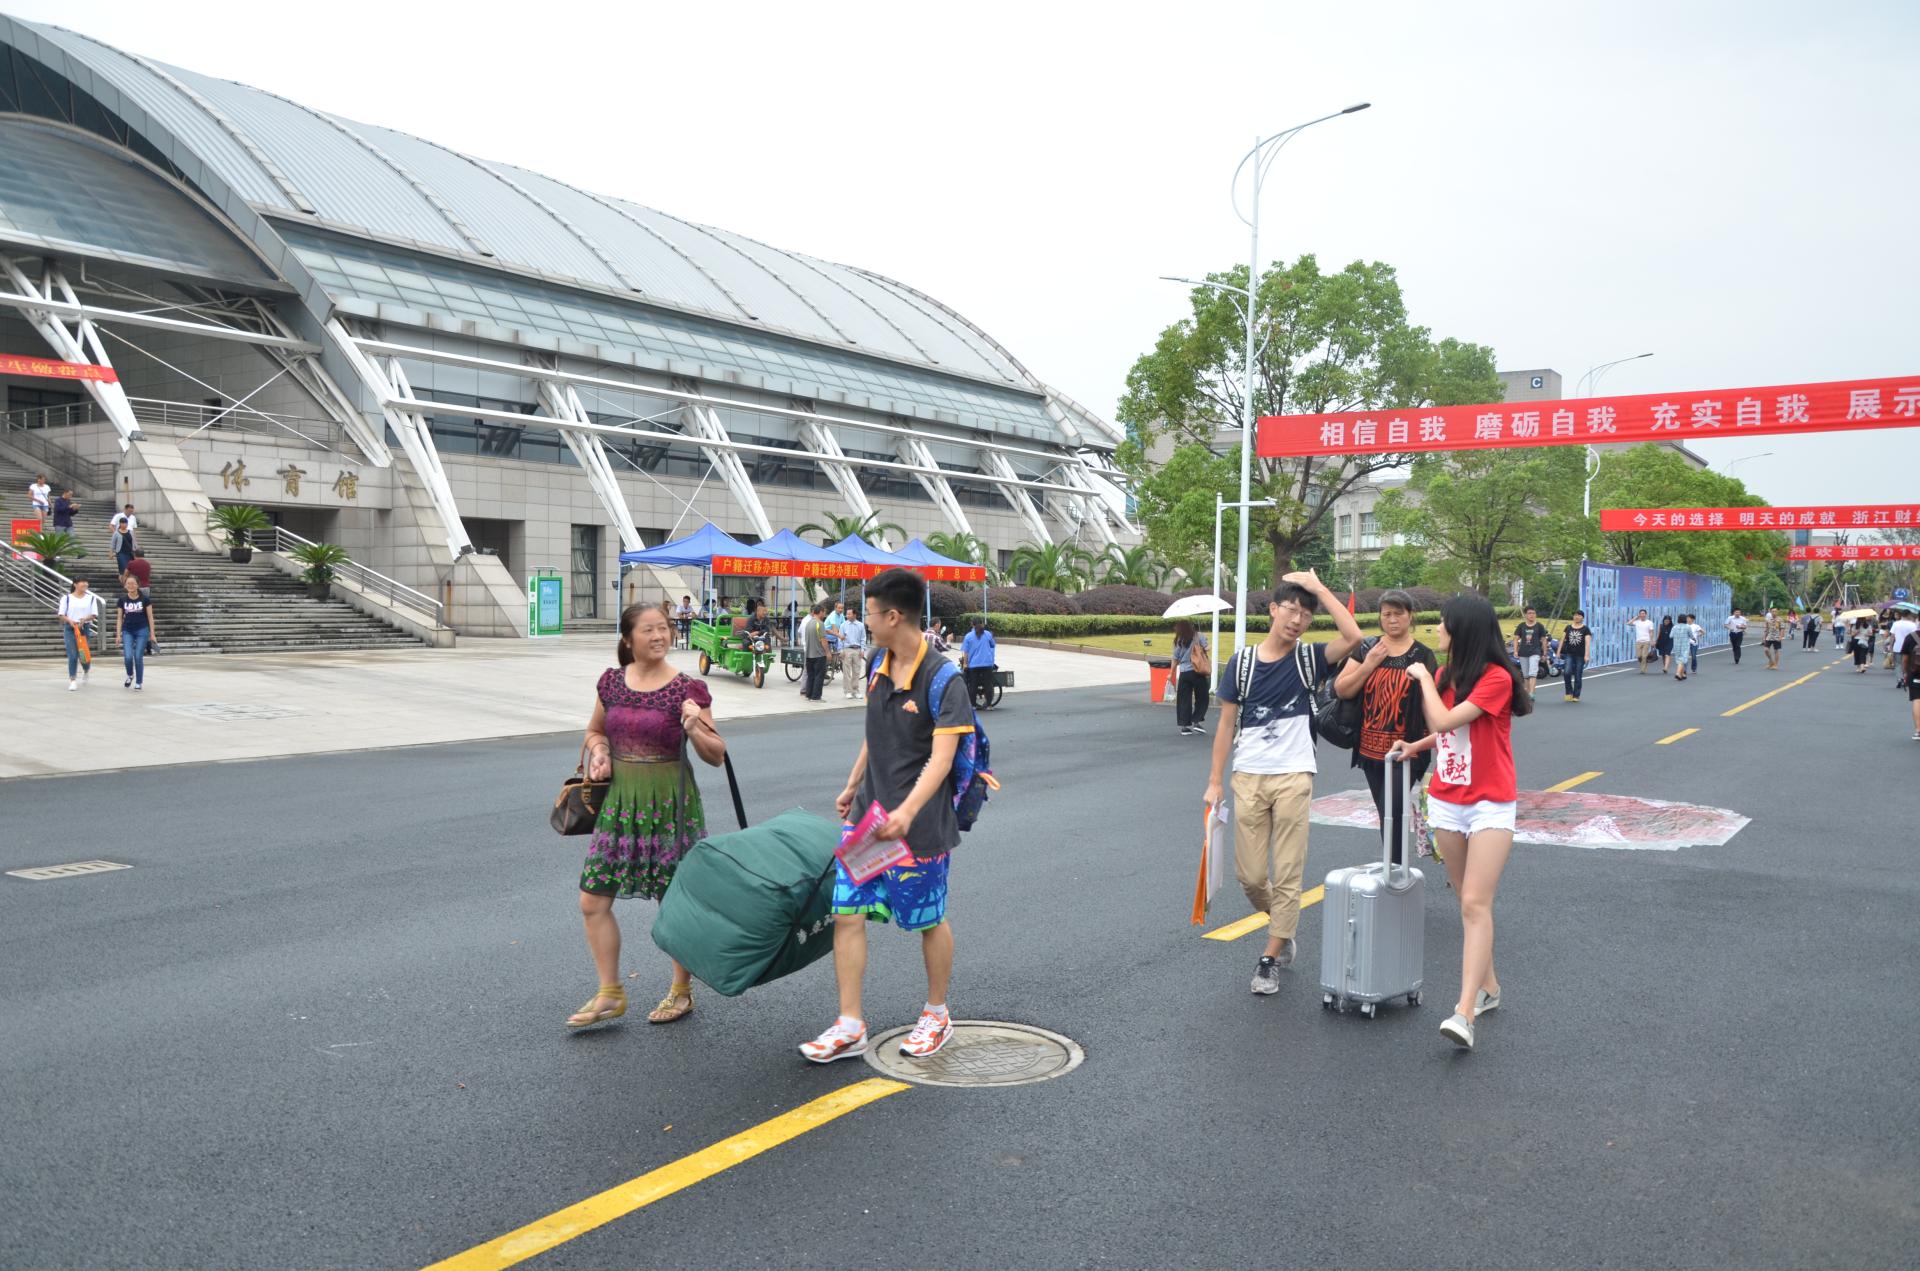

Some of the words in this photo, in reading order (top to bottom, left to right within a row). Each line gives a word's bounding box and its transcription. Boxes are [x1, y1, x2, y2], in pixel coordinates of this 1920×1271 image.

[1532, 377, 1541, 387] C
[1320, 416, 1446, 446] 相信自我
[1474, 406, 1616, 439] 磨砺自我
[1651, 394, 1809, 431] 充实自我
[1847, 388, 1920, 419] 展示
[220, 459, 359, 500] 体育馆
[1633, 512, 1724, 526] 今天的选择
[1740, 511, 1836, 525] 明天的成就
[1852, 510, 1920, 524] 浙江财
[723, 558, 788, 574] 户籍迁移办理区
[803, 562, 858, 577] 户籍迁移办理区
[937, 568, 976, 579] 休息区
[124, 601, 143, 610] LOVE
